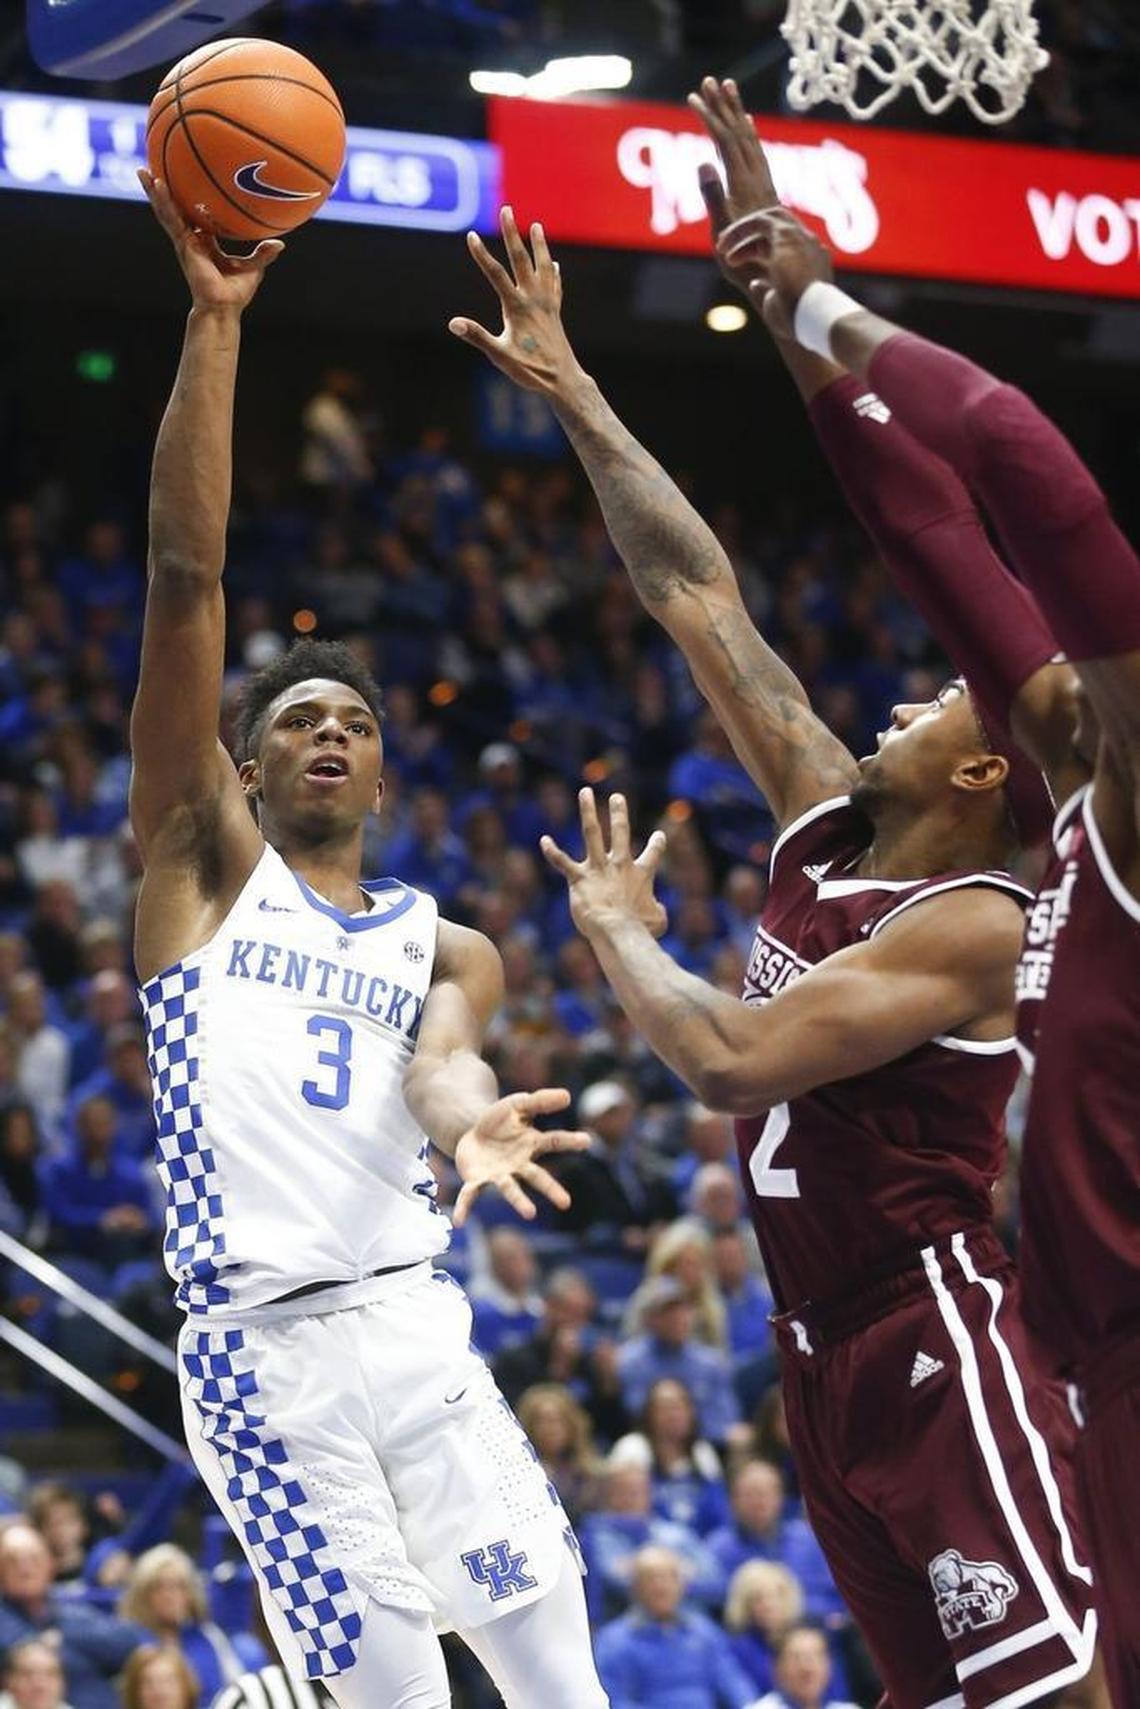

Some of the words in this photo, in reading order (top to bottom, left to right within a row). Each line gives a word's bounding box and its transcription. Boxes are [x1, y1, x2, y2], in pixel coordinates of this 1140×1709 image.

[301, 1014, 353, 1111] 3
[749, 1102, 800, 1197] 2
[460, 1539, 538, 1601] UK
